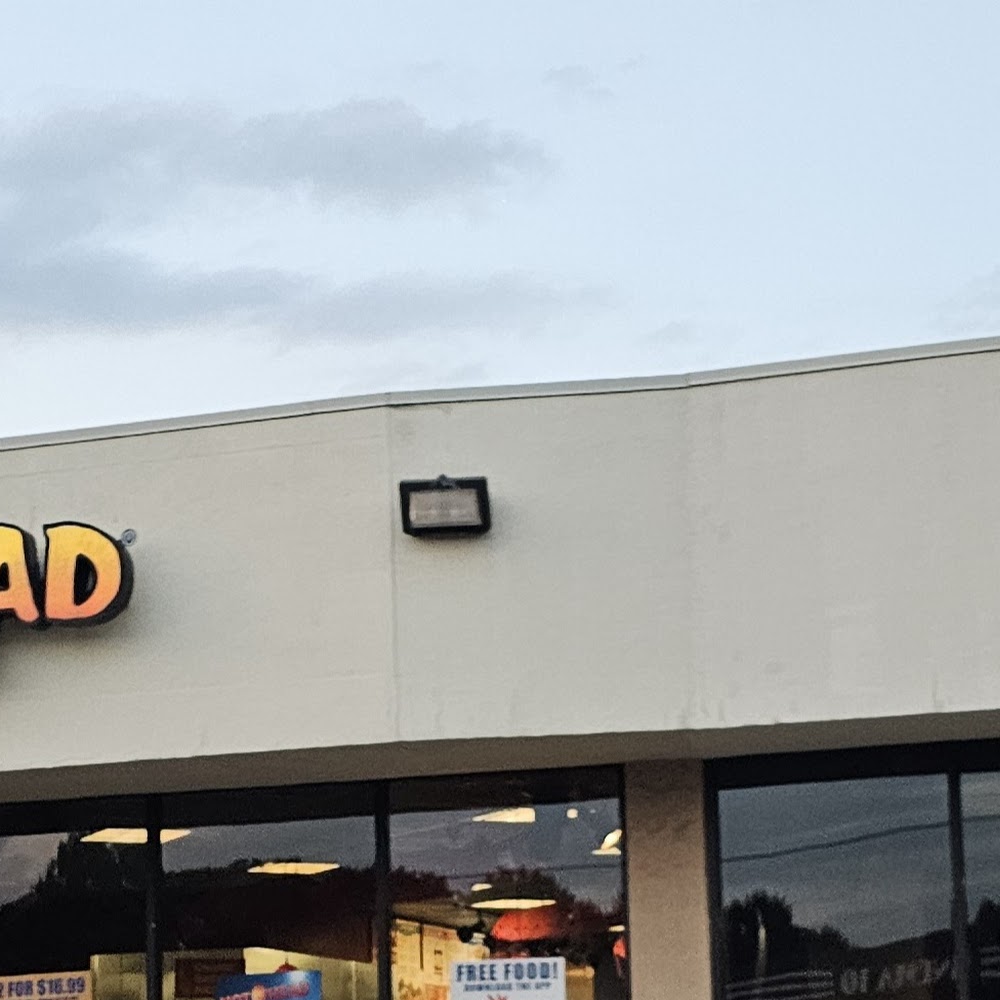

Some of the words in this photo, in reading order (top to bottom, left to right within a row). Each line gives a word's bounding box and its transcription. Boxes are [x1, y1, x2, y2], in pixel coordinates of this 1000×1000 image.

[456, 963, 497, 982] FREE
[504, 961, 558, 980] FOOD!
[7, 979, 34, 997] FOR
[36, 976, 86, 996] $16.99
